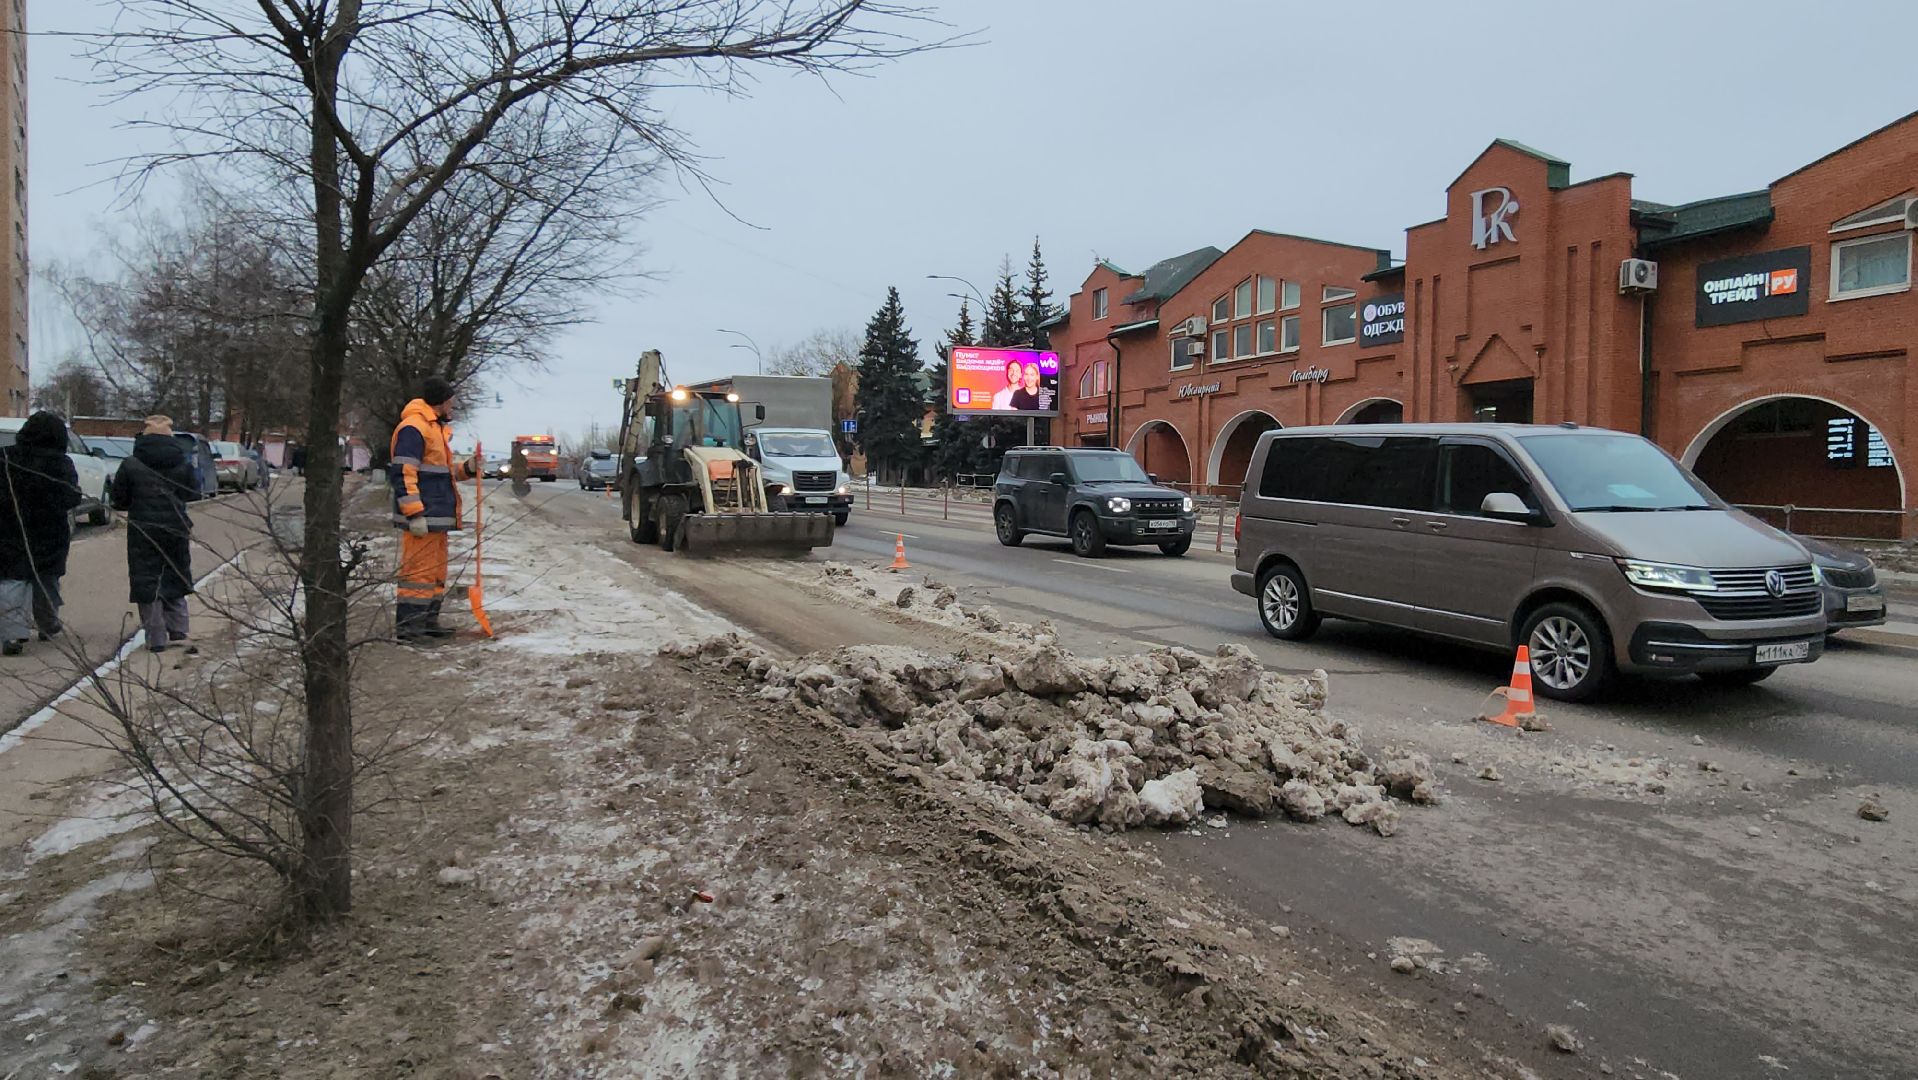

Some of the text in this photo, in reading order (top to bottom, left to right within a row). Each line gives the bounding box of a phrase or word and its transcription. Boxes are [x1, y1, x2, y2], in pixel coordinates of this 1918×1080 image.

[1704, 273, 1764, 293] ОНЛАЙН
[1709, 287, 1757, 305] ТРЕЙД
[1377, 301, 1405, 317] ОБУВ
[1363, 318, 1404, 338] ОДЕЖД
[1040, 357, 1057, 369] wb
[1288, 365, 1330, 383] Ломбард
